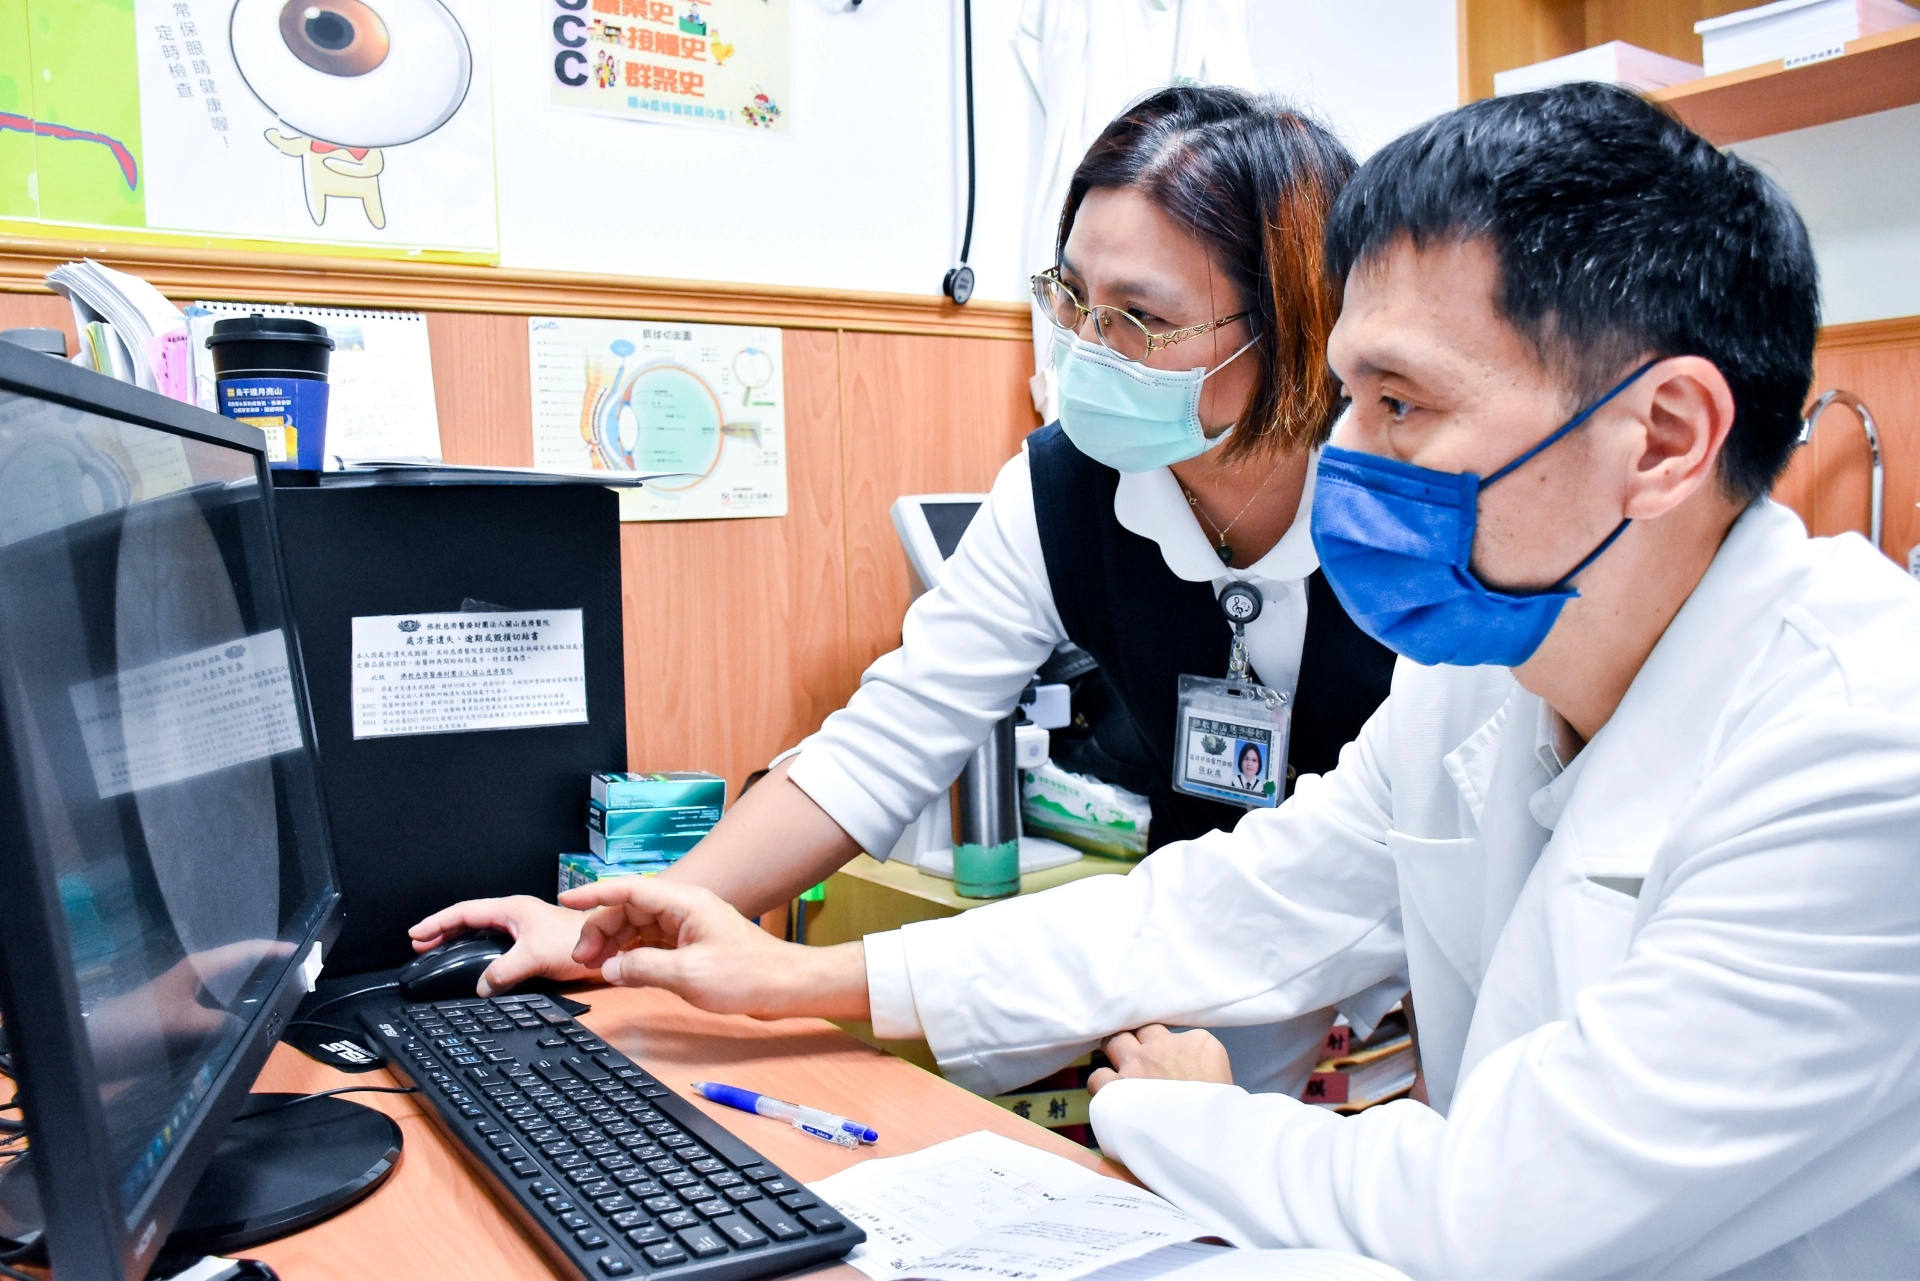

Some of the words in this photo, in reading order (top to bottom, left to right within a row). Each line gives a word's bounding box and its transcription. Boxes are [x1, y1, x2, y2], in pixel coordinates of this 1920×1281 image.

[154, 25, 194, 99] 定時檢查
[627, 26, 707, 62] 接觸史
[625, 61, 705, 97] 群聚史
